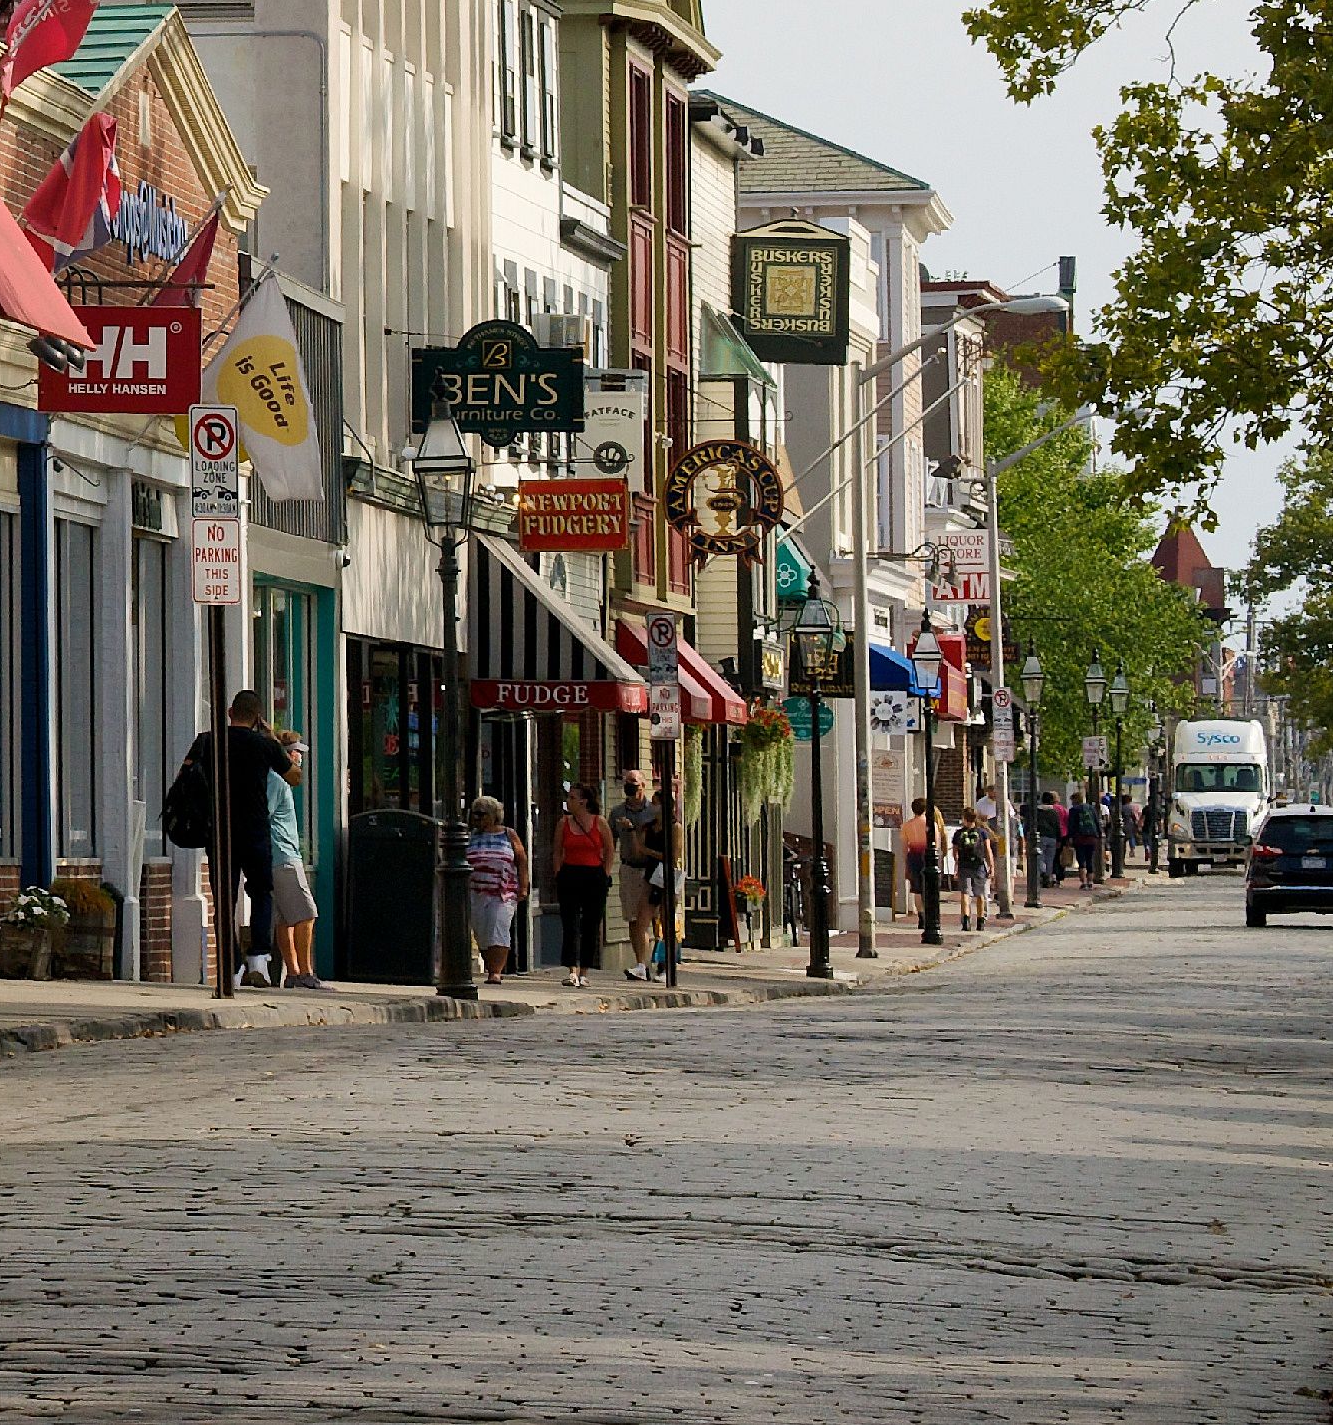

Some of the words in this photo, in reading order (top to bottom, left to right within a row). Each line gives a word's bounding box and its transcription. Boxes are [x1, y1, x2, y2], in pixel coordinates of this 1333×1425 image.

[750, 249, 833, 263] BUSKERS
[234, 355, 255, 375] is
[68, 382, 109, 394] HELLY
[112, 383, 168, 396] HANSEN
[269, 361, 295, 406] Life
[440, 373, 559, 406] BEN'S
[456, 407, 523, 422] urniture
[529, 407, 561, 422] Co.
[585, 406, 637, 420] FATFACE
[194, 461, 236, 472] LOADING
[203, 472, 227, 484] ZONE
[667, 444, 762, 513] AMERICA'S
[758, 470, 780, 514] CUP
[523, 493, 623, 512] NEWPORT
[523, 515, 623, 535] FUDGERY
[207, 525, 225, 542] NO
[704, 537, 746, 552] INN
[938, 535, 985, 547] LIQUOR
[195, 547, 238, 563] PARKING
[940, 548, 983, 559] STORE
[205, 568, 229, 580] THIS
[205, 584, 229, 596] SIDE
[935, 573, 991, 599] ATM
[496, 683, 590, 704] FUDGE
[659, 689, 670, 700] NO
[652, 702, 679, 713] PARKING
[661, 716, 674, 724] HIS
[1197, 732, 1241, 746] Sysco
